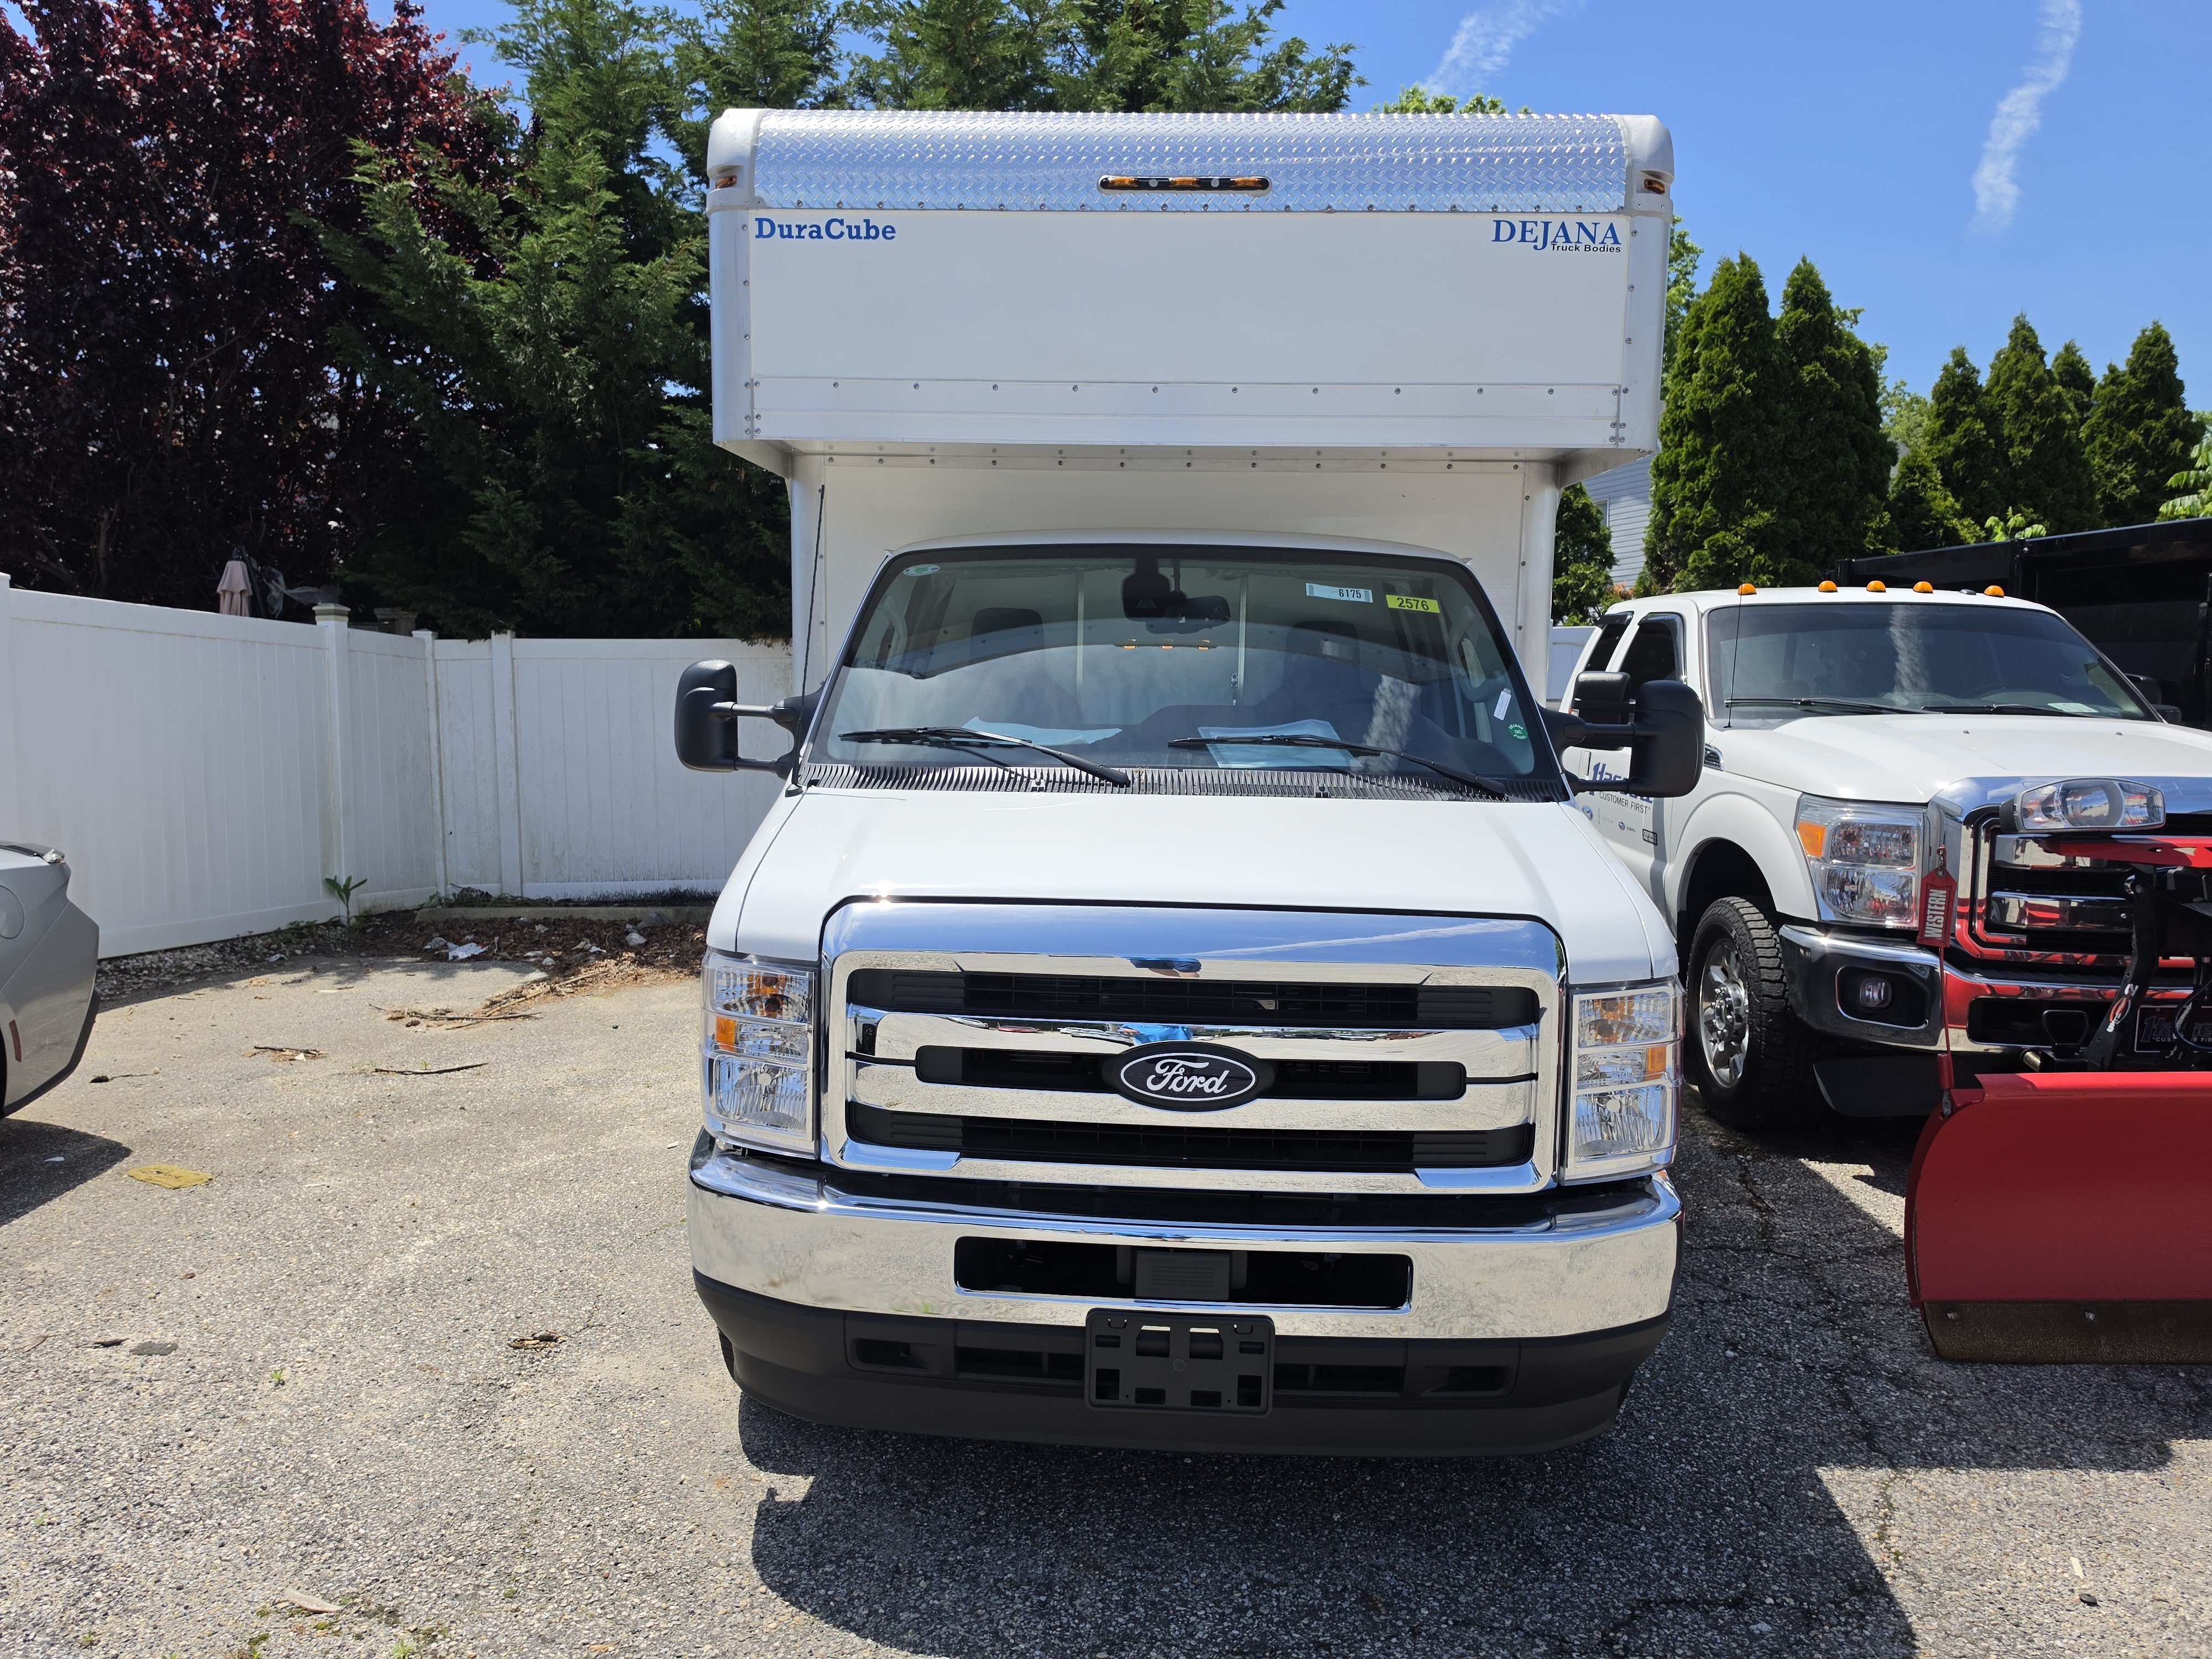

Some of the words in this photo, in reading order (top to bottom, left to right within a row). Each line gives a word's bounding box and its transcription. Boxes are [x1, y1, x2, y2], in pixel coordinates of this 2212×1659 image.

[754, 217, 896, 241] DuraCube
[1491, 220, 1621, 251] DEJANA
[1551, 243, 1580, 252] Truck
[1584, 244, 1621, 253] Bodies
[1338, 588, 1361, 599] 6175
[1396, 597, 1429, 611] 2576
[1924, 889, 1947, 937] WESTERN
[1146, 1059, 1230, 1093] Ford
